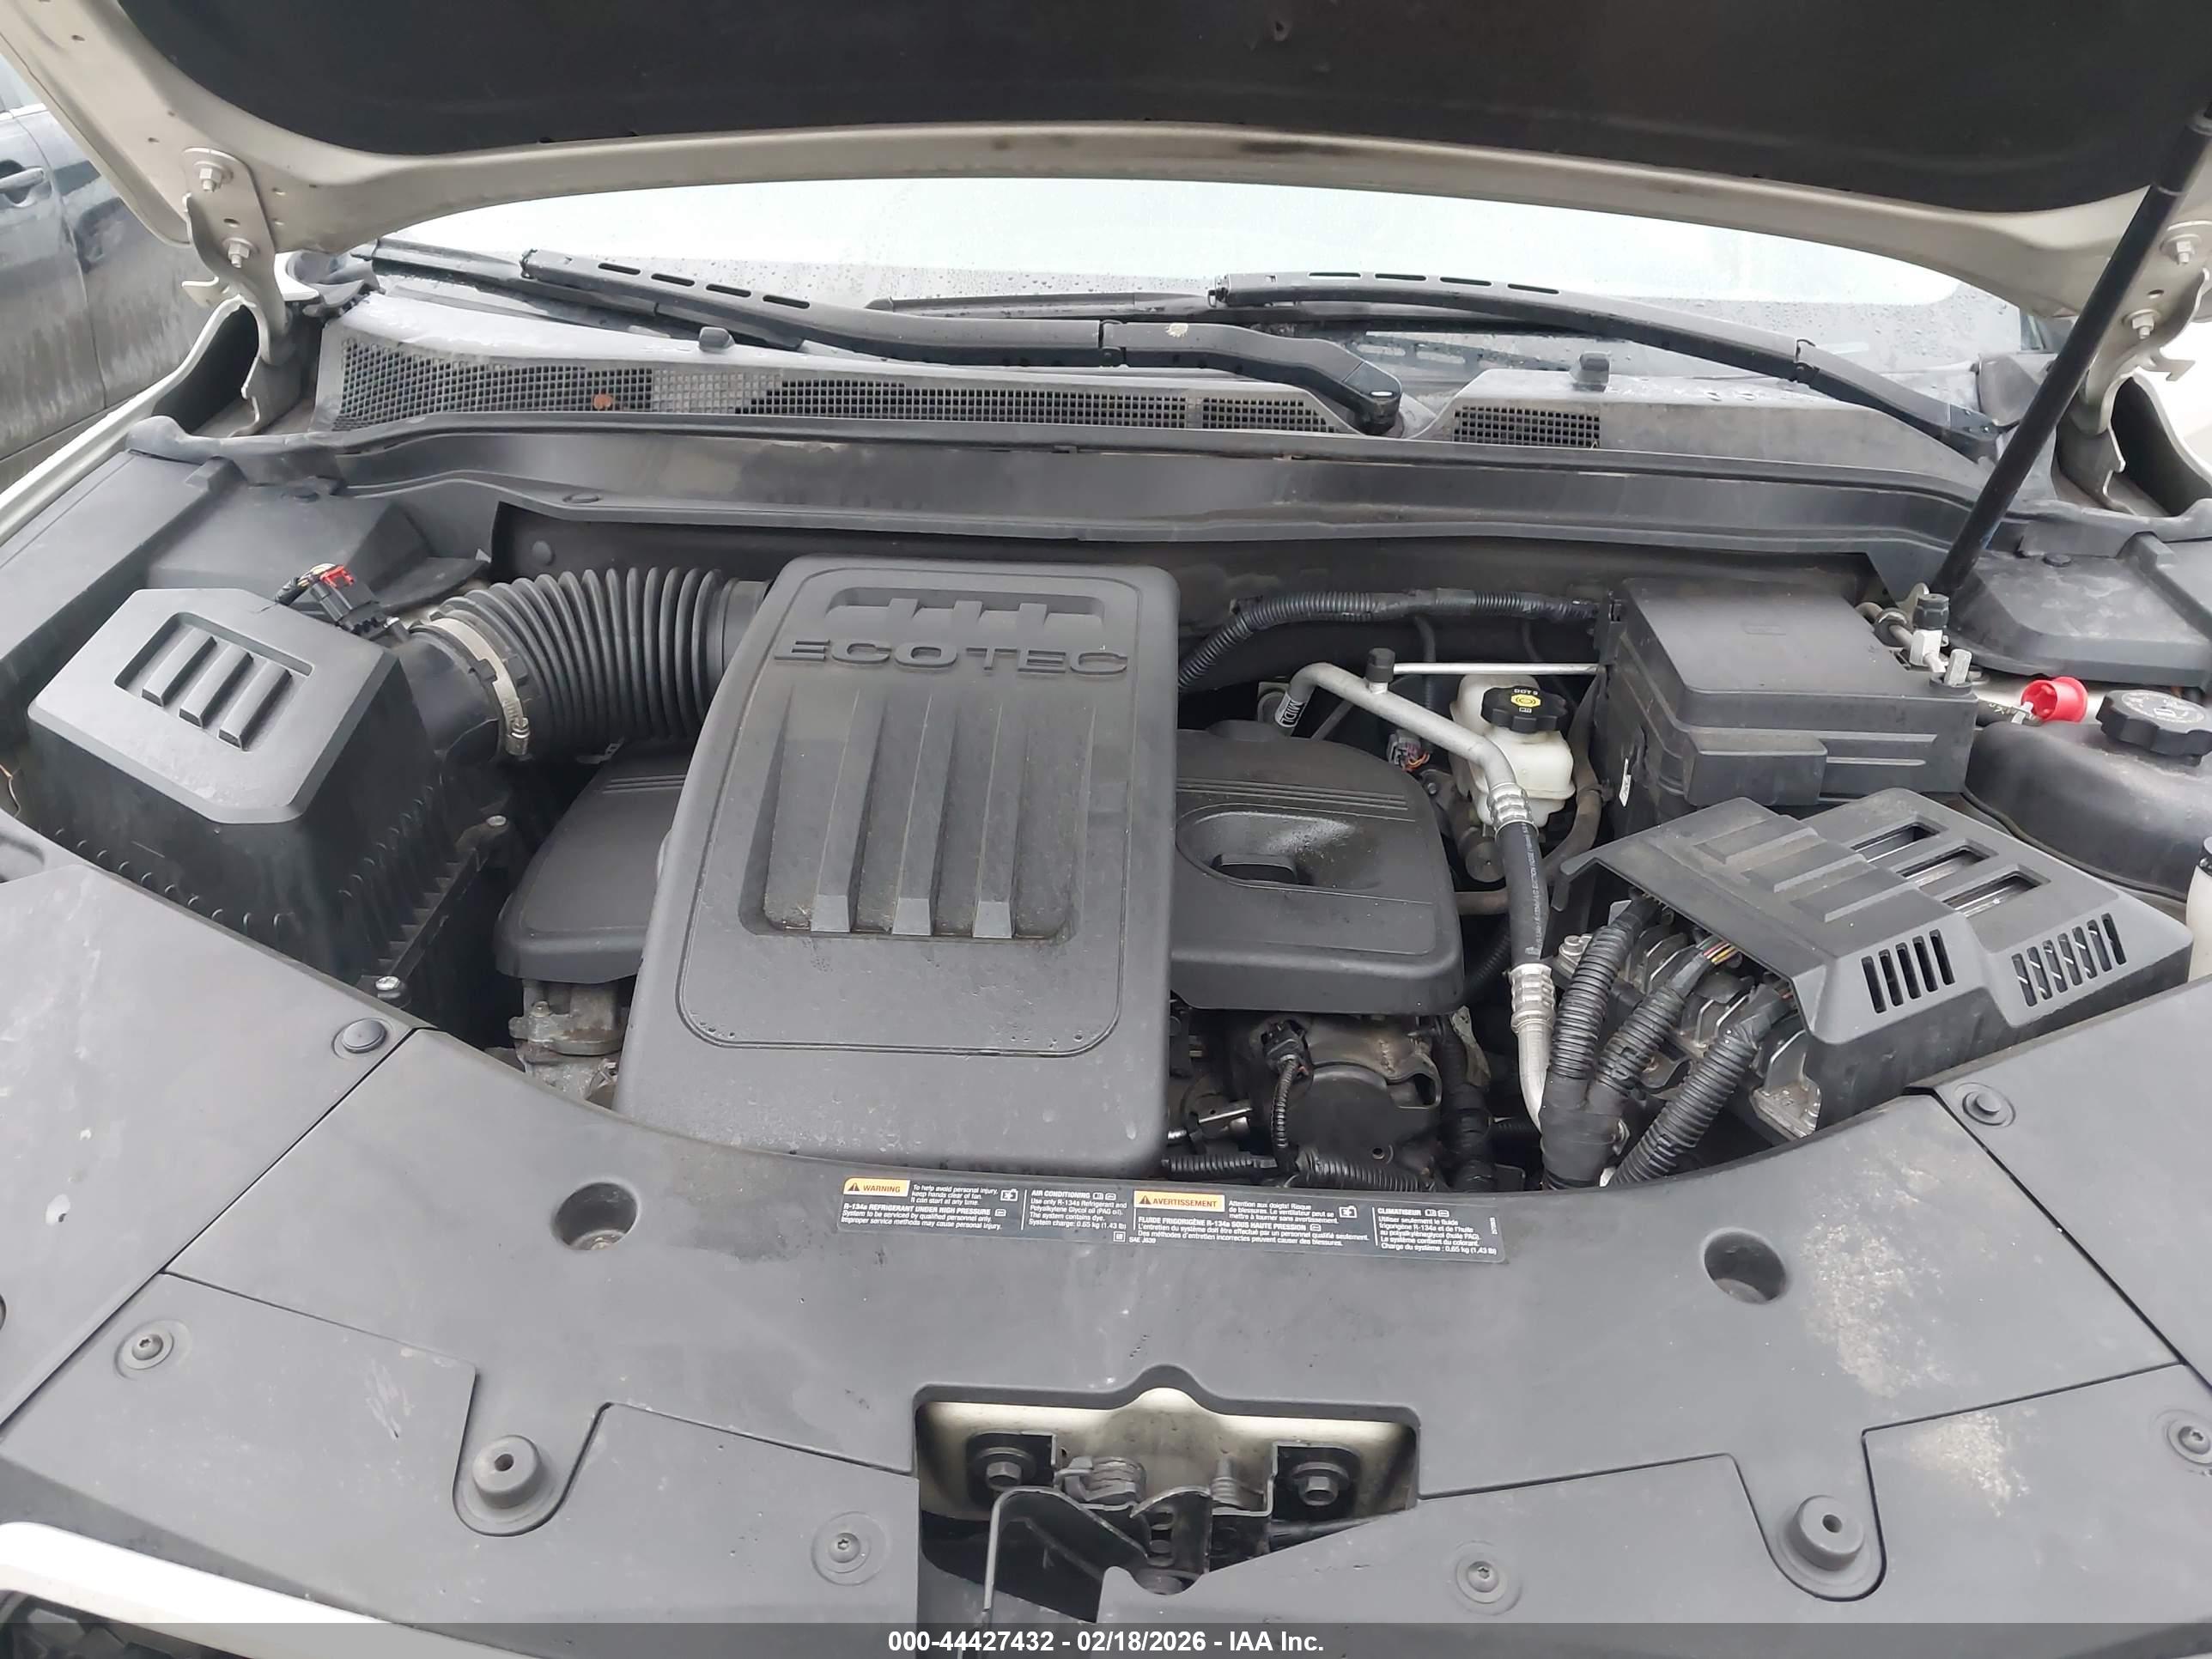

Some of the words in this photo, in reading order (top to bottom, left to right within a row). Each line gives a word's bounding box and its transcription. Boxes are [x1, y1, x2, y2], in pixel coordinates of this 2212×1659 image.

[775, 639, 1128, 676] ECOTEC
[1152, 1198, 1217, 1207] AVERTISSEMENT
[869, 1204, 915, 1212] REFRIGERANT
[956, 1207, 991, 1216] PRESSURE
[1052, 1219, 1075, 1228] charge:
[1162, 1218, 1206, 1226] FRIGORIGÈNE
